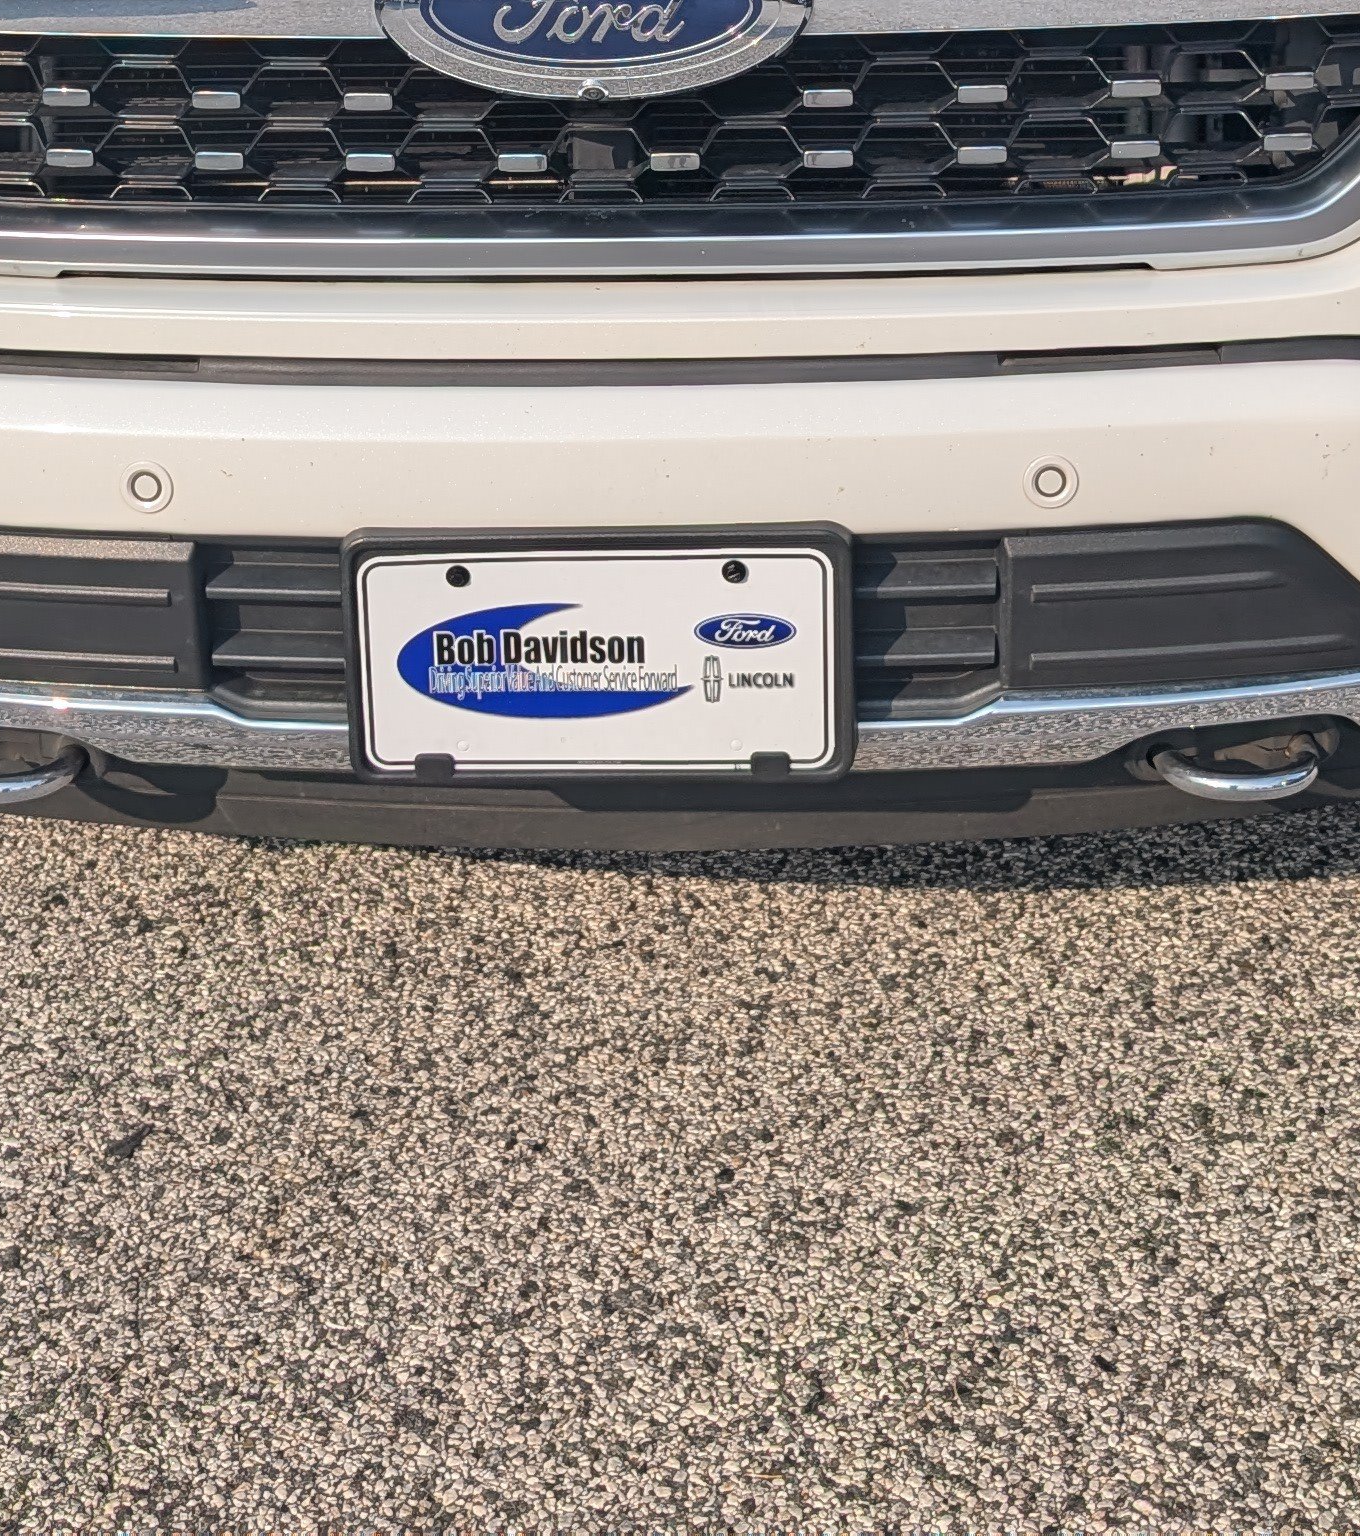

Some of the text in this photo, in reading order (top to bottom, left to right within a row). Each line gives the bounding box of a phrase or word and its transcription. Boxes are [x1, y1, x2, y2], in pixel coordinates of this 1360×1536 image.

[714, 618, 775, 643] Ford
[434, 629, 646, 666] Bob Davidson
[429, 665, 466, 701] Driving
[465, 665, 505, 700] Superior
[555, 665, 603, 691] Customer
[602, 664, 638, 692] Service
[638, 664, 678, 692] Forward
[728, 672, 796, 689] LINCOLN
